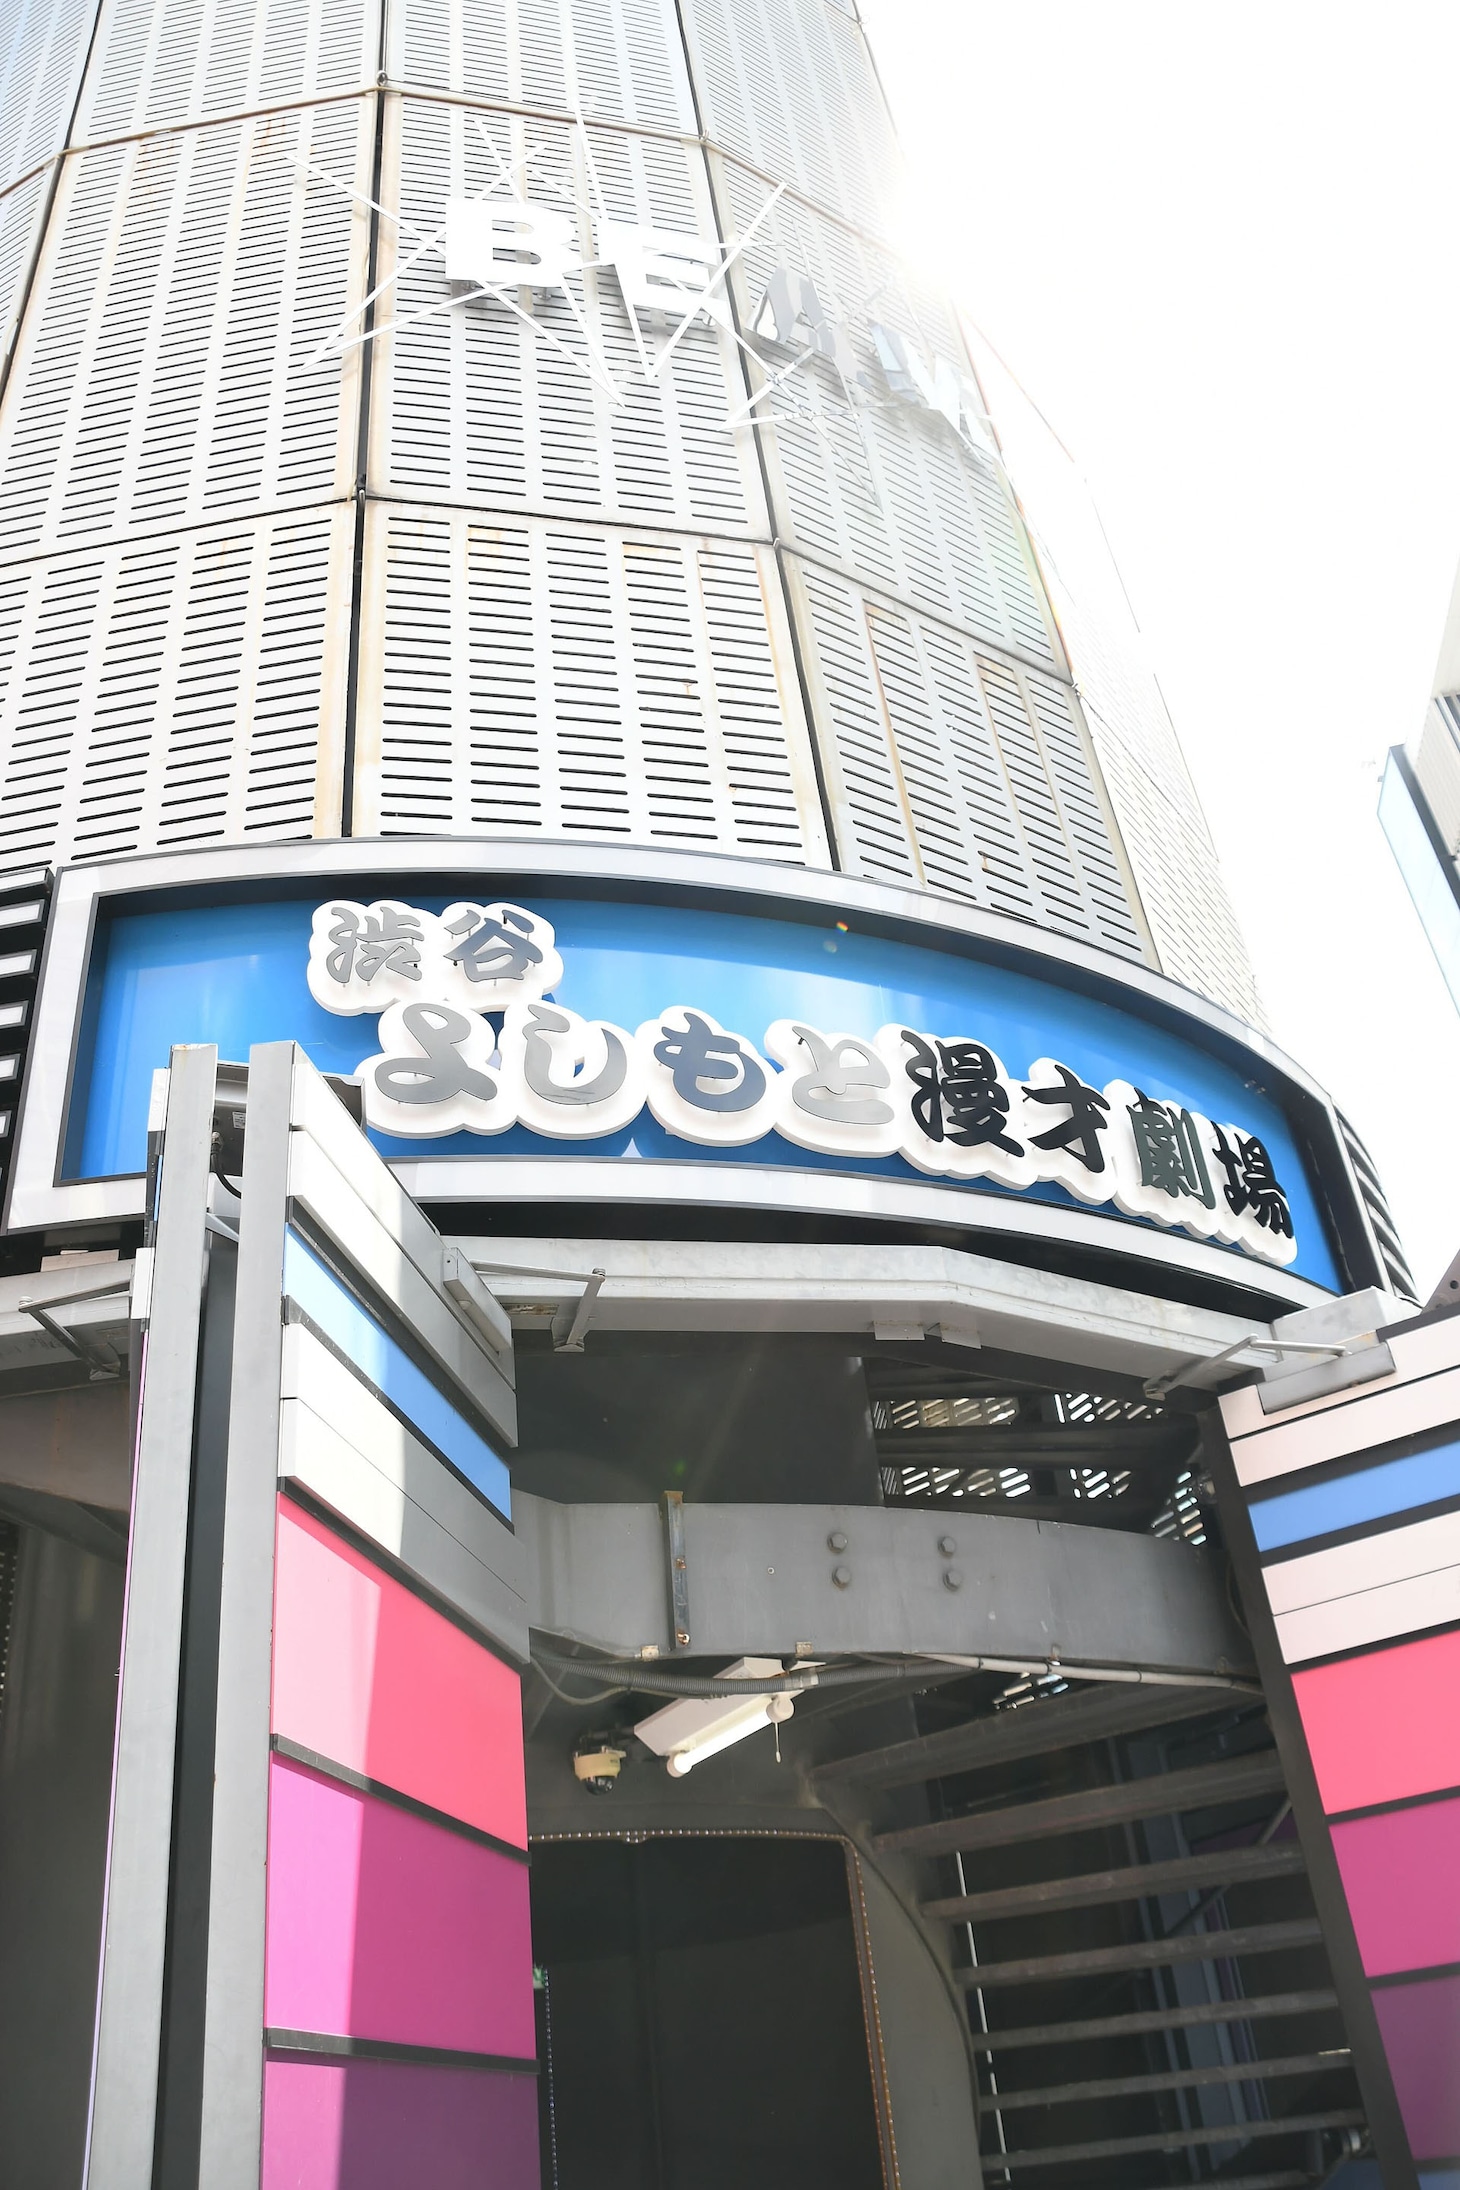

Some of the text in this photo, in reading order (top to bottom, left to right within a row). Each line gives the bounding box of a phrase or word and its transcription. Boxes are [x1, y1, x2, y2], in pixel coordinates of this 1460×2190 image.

[445, 198, 1003, 464] BEAM
[325, 905, 544, 984] 渋谷
[374, 1002, 1295, 1239] よしもと漫才劇場
